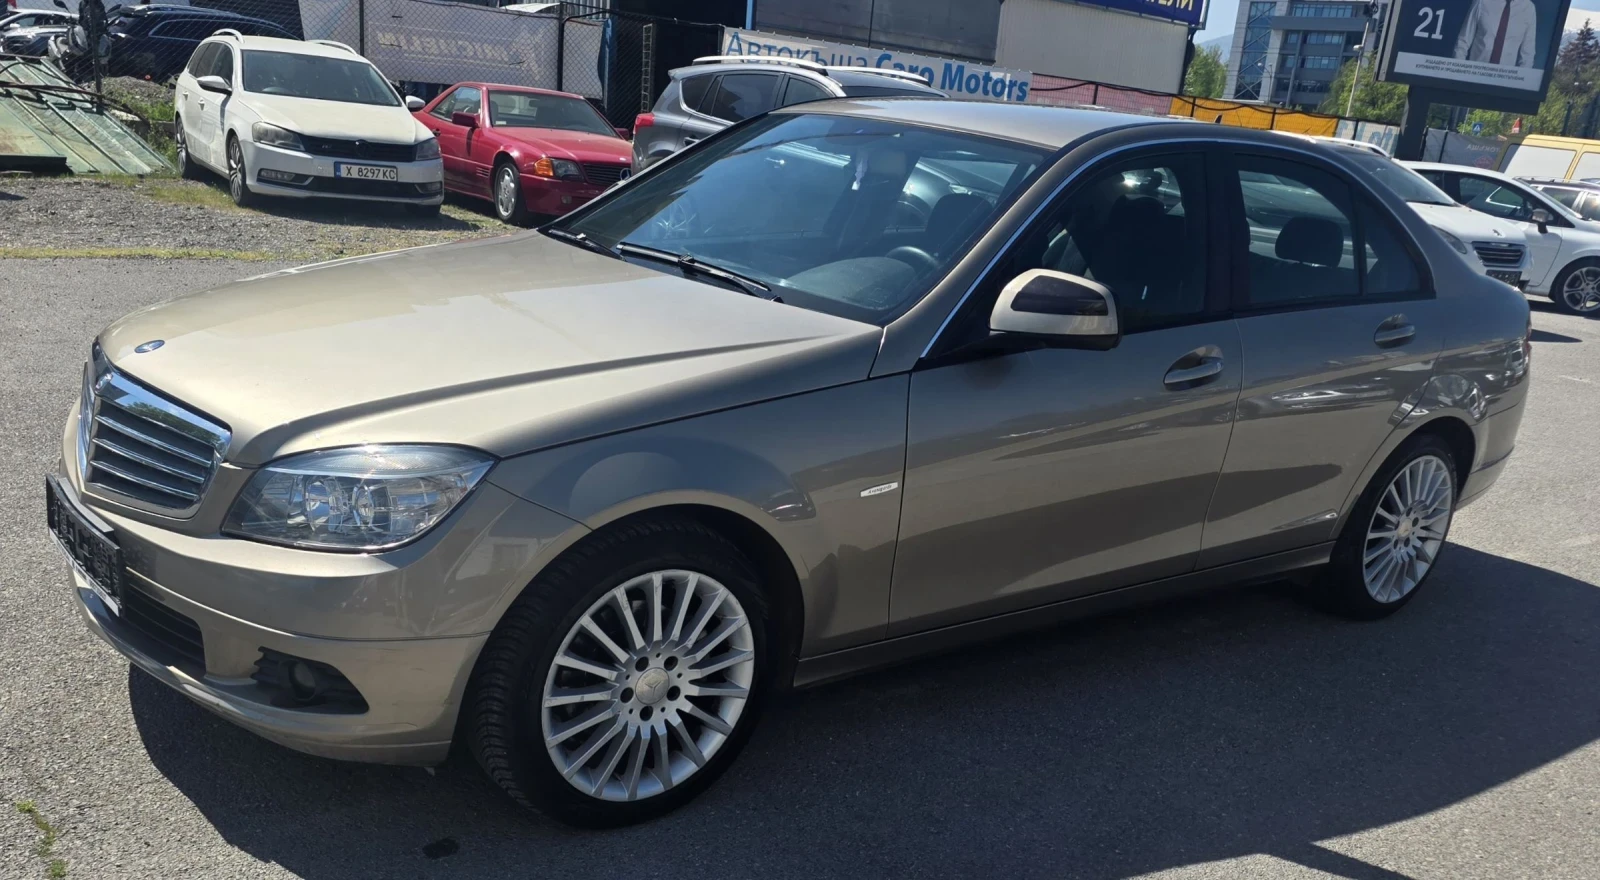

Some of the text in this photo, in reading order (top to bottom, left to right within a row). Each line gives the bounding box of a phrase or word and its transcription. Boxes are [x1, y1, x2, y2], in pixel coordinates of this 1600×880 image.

[1413, 6, 1446, 40] 21
[940, 62, 1029, 102] Motors
[357, 167, 381, 178] 8297
